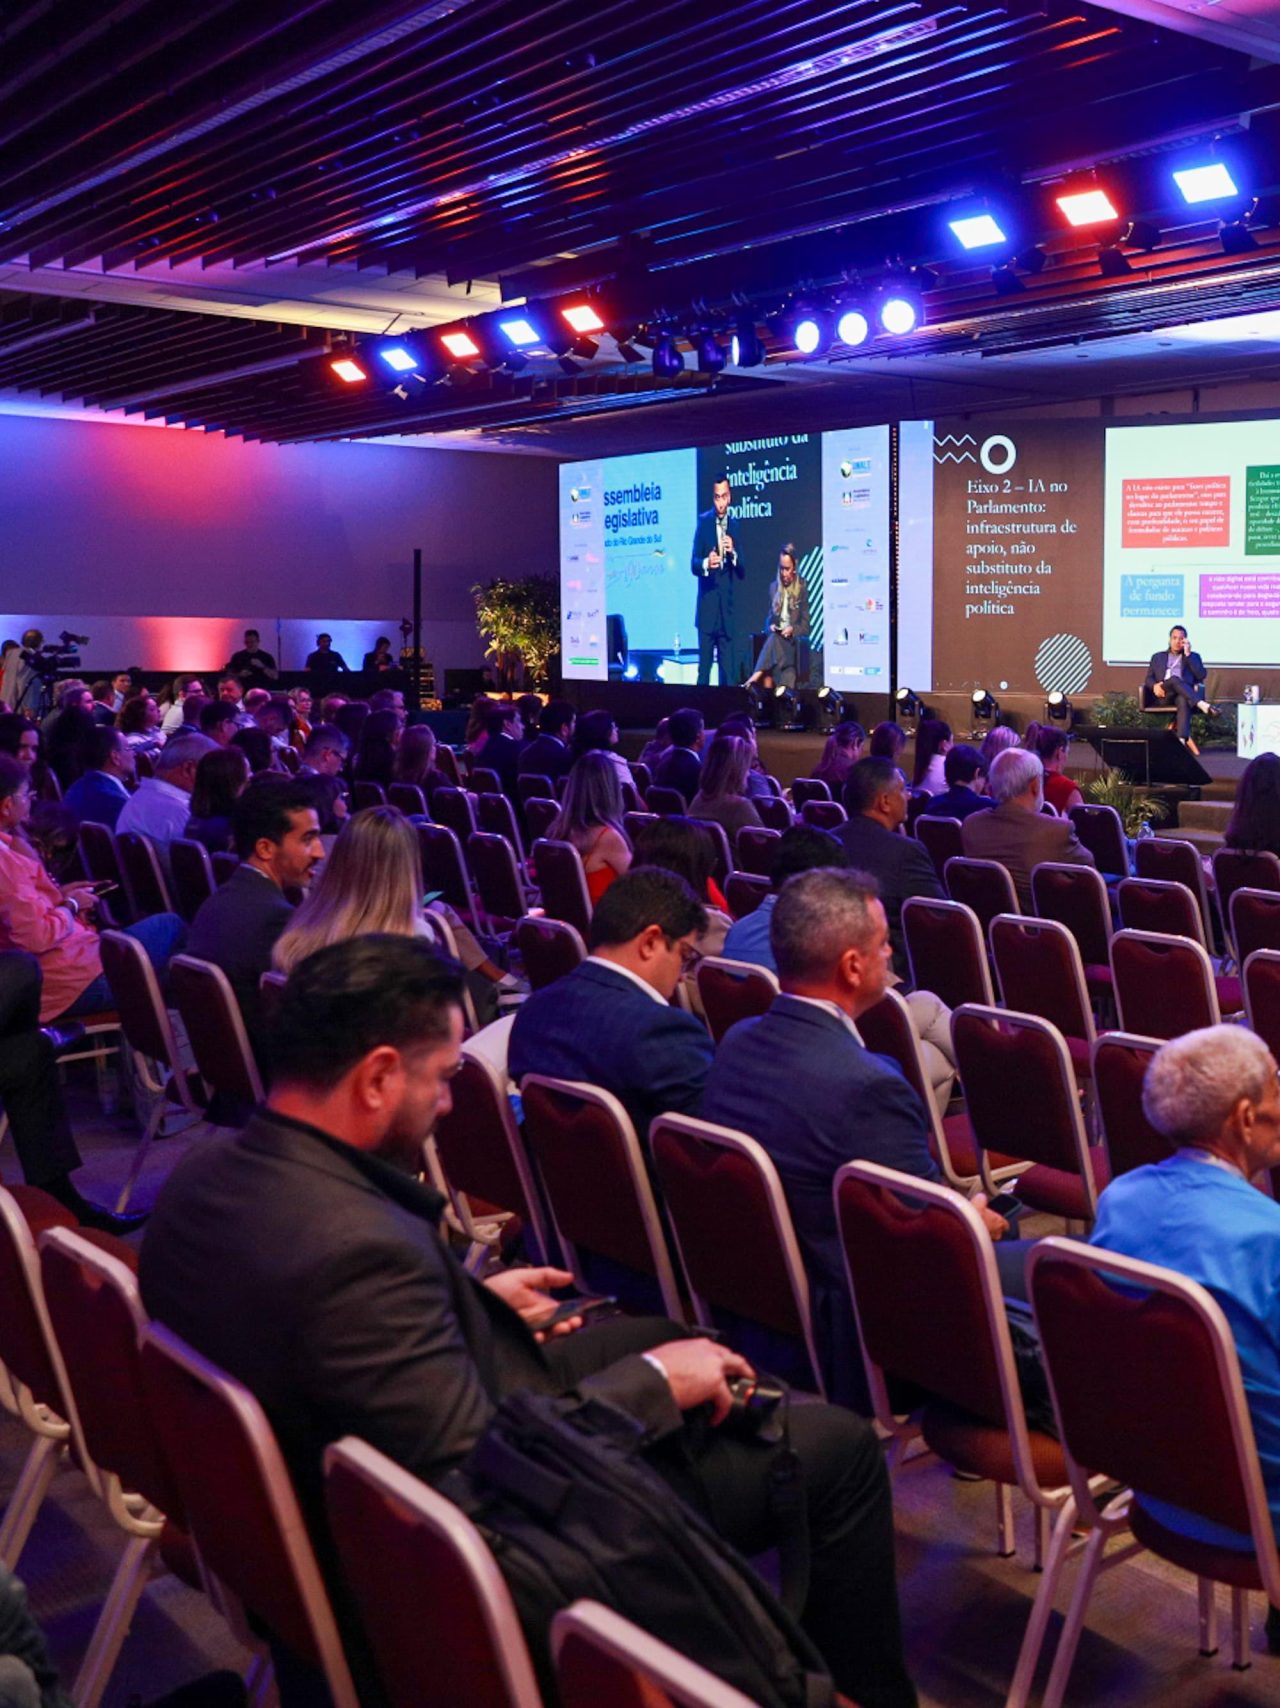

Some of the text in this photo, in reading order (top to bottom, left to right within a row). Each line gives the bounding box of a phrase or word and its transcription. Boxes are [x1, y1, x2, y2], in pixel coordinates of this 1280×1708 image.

[967, 479, 999, 494] Eixo
[1002, 480, 1011, 494] 2
[1028, 479, 1045, 493] IA
[1050, 482, 1068, 493] no
[967, 499, 1046, 514] Parlamento:
[966, 518, 1078, 534] infraestrutura de
[966, 540, 1036, 559] apoio, não
[966, 560, 1051, 574] substituto da
[966, 580, 1041, 599] inteligência
[1124, 576, 1180, 590] A pergunta
[1129, 590, 1176, 601] de fundo
[965, 600, 1015, 619] política
